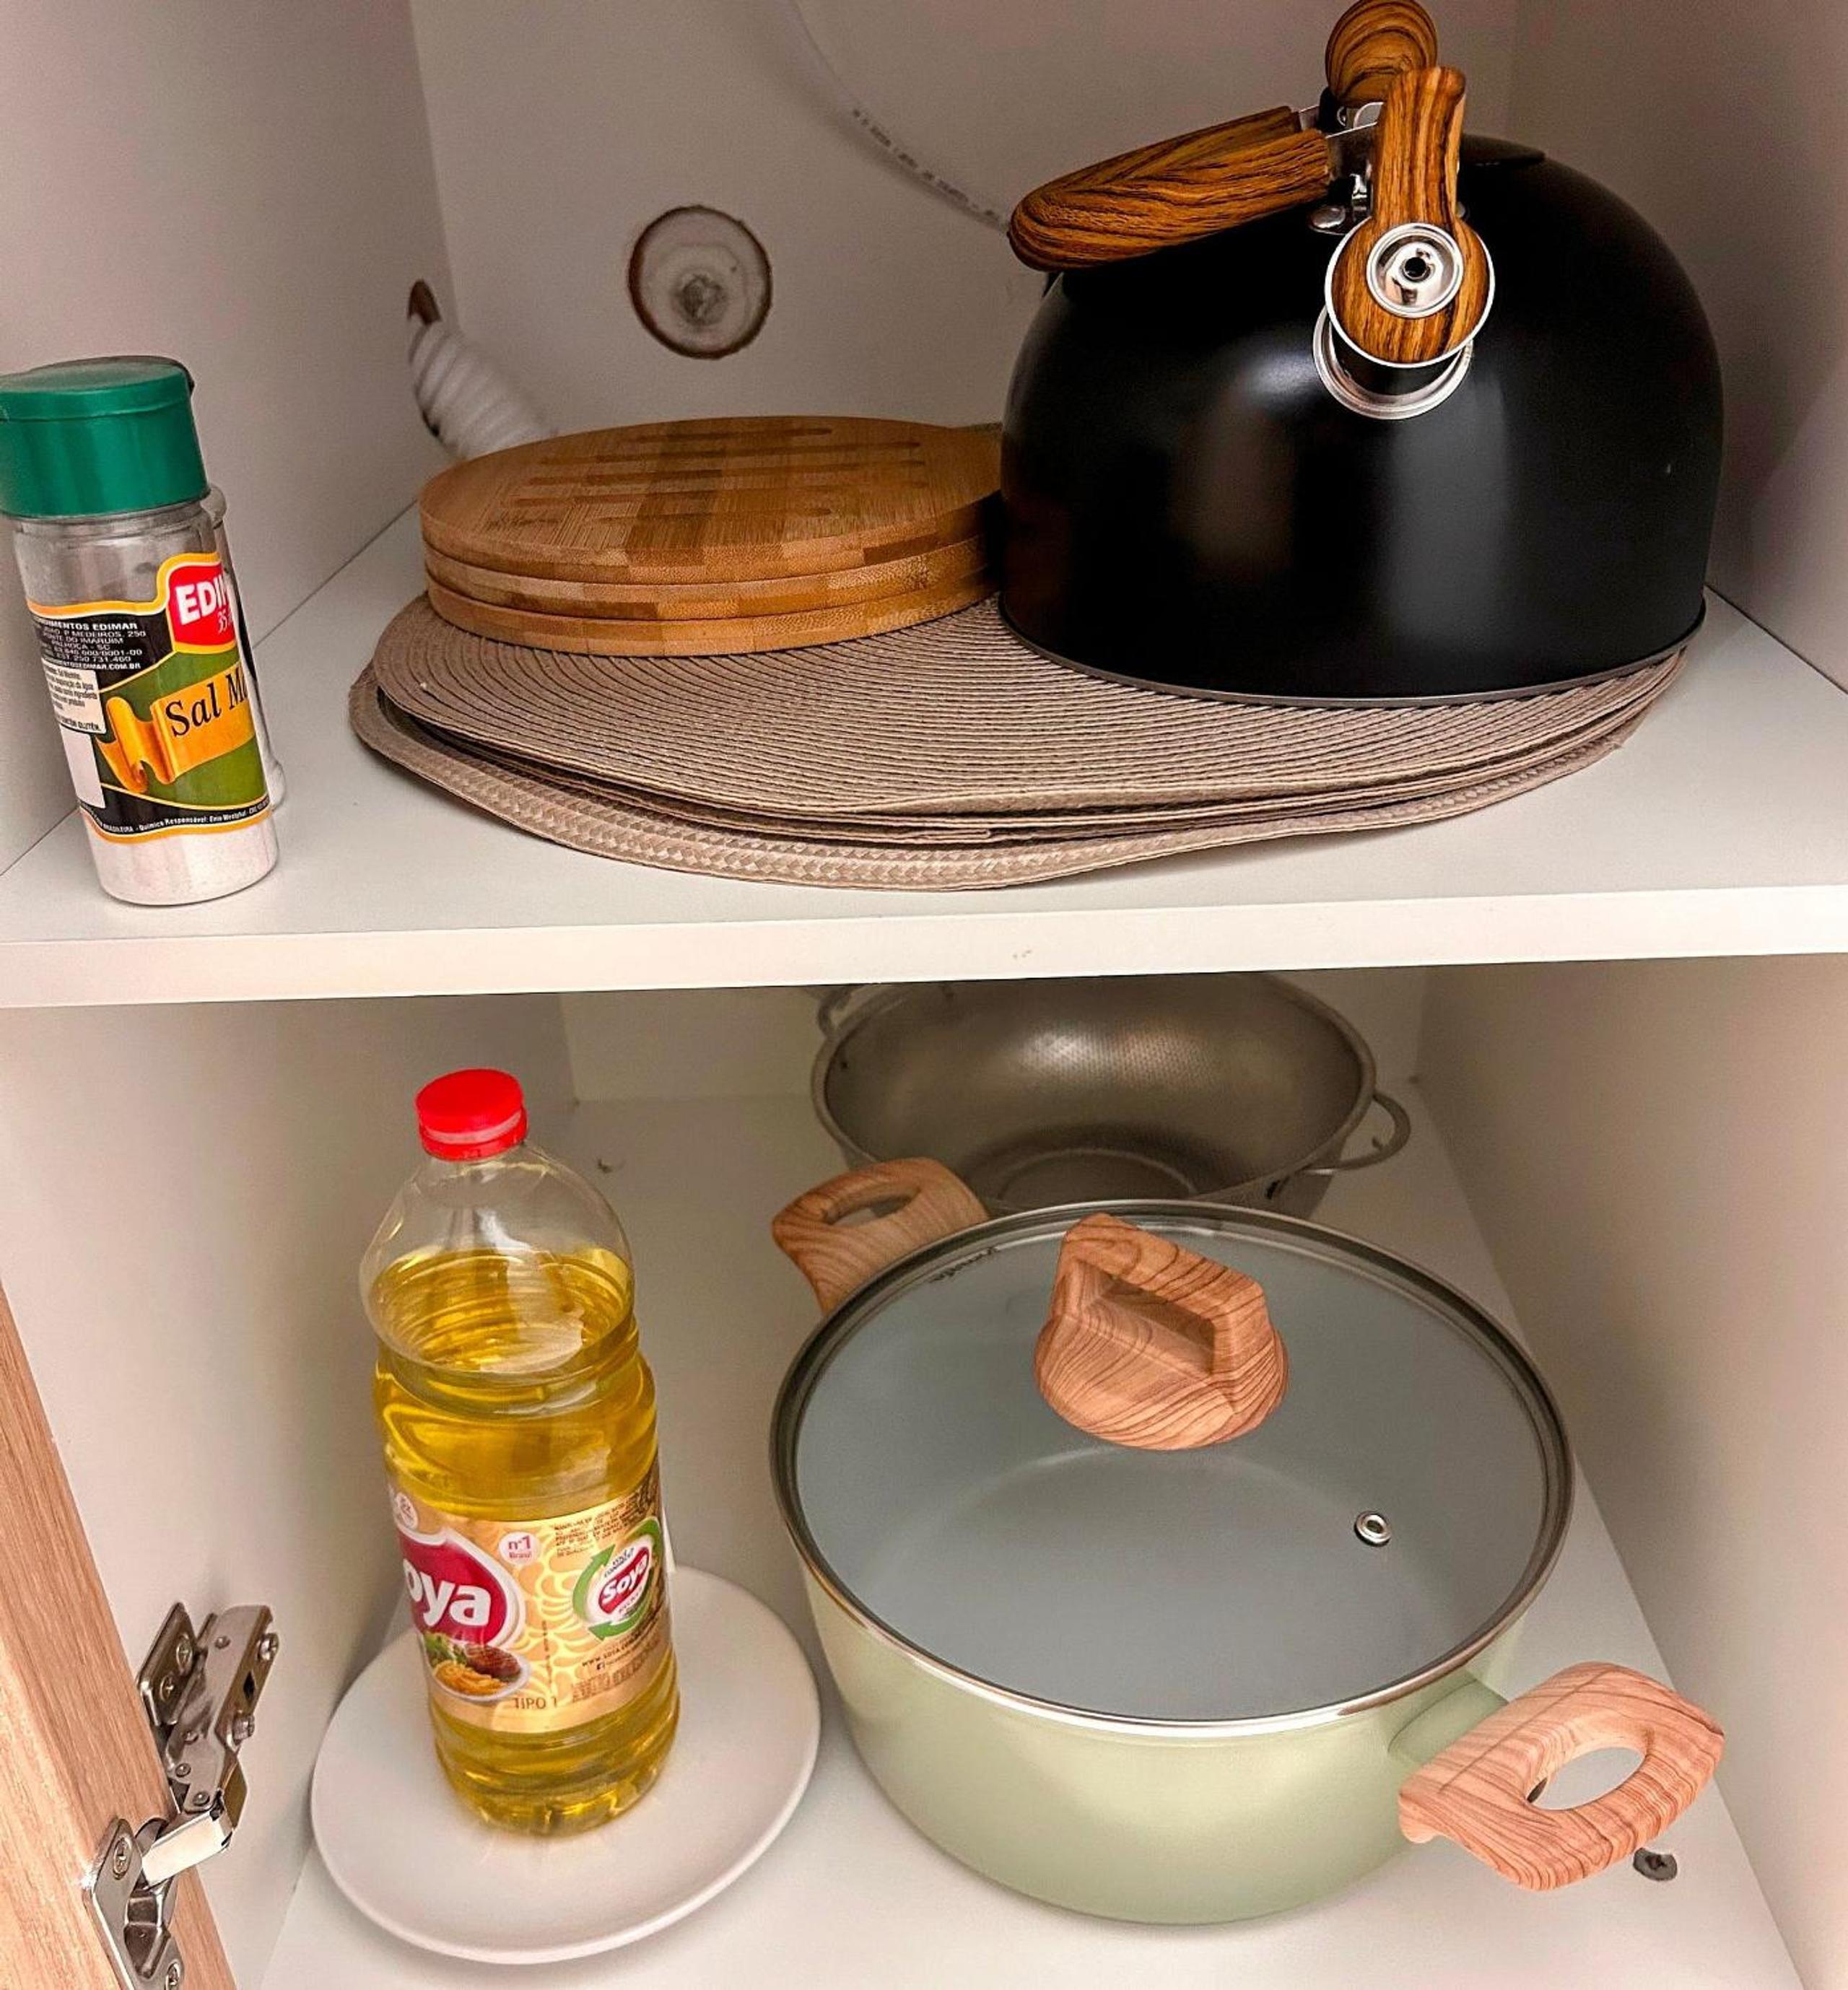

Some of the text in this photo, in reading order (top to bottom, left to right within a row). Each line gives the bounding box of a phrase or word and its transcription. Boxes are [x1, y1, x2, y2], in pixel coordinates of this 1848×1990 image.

[92, 622, 138, 631] EDIMAR
[165, 681, 222, 736] Sal
[513, 1697, 547, 1710] TIPO
